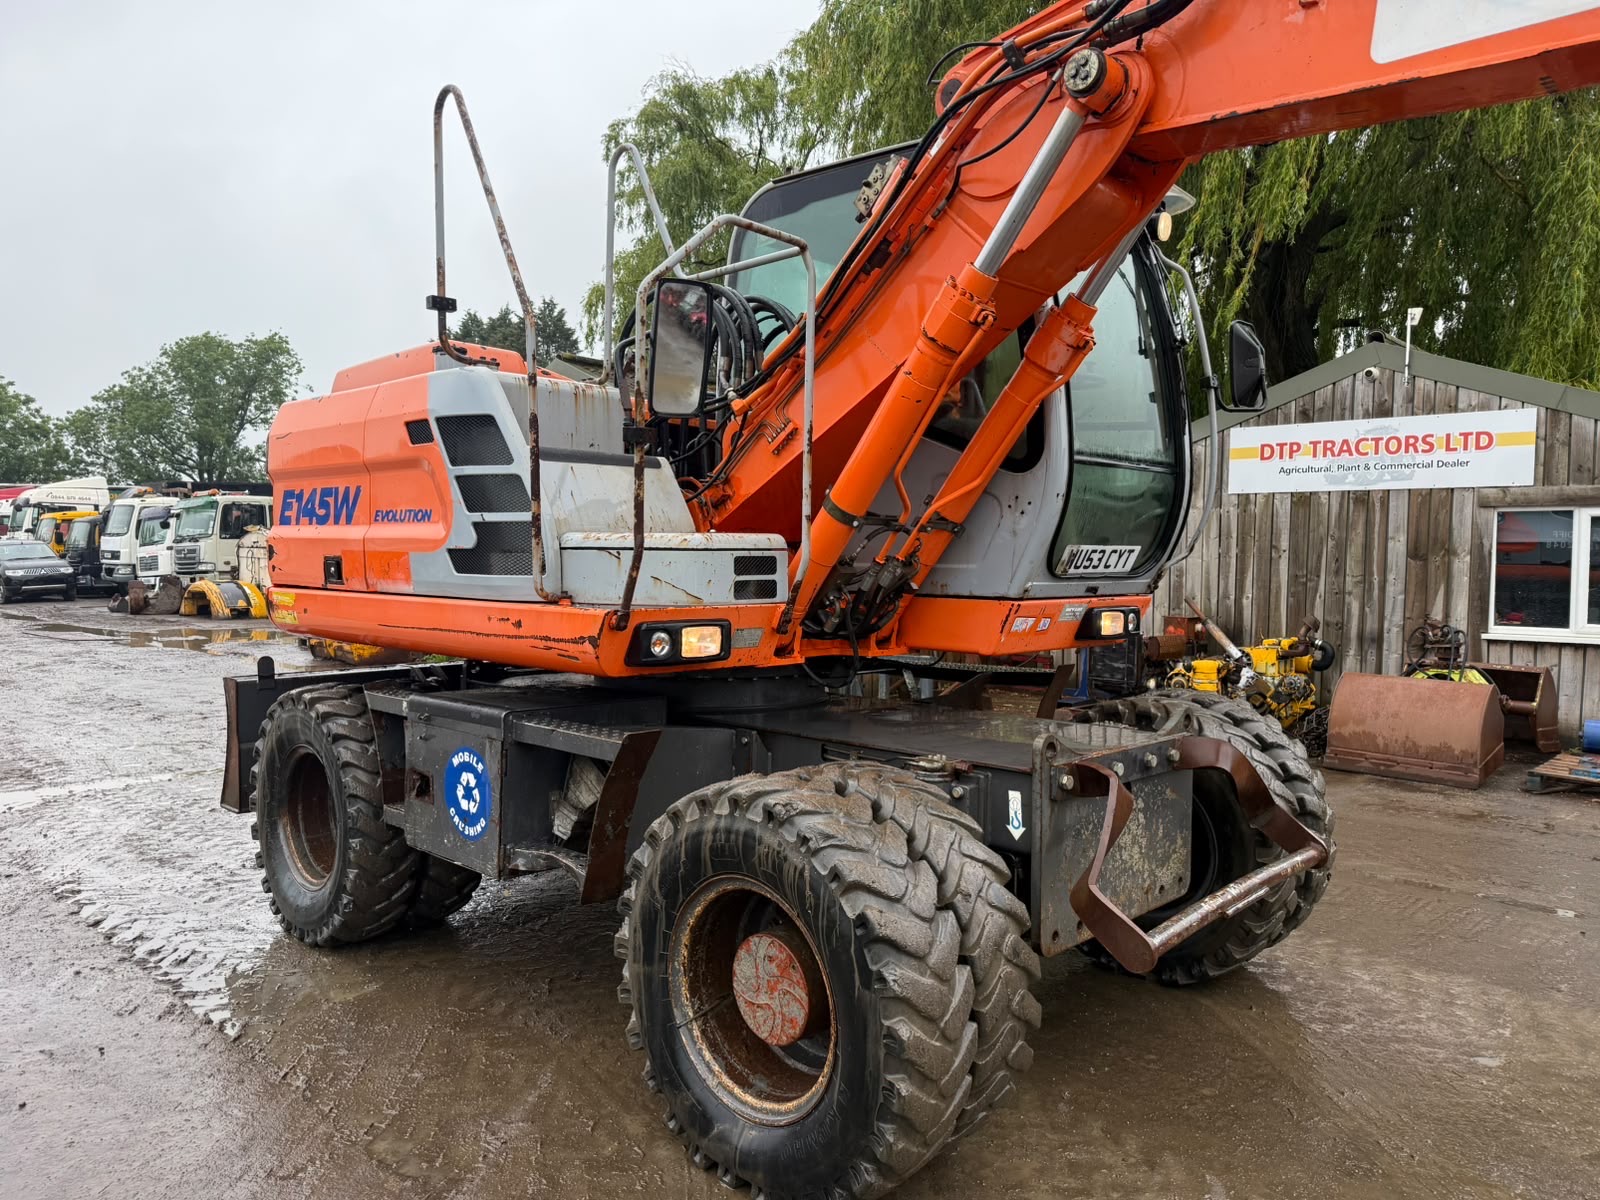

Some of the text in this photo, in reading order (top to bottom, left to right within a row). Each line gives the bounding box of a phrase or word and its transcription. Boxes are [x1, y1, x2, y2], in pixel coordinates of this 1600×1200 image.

[1260, 431, 1494, 461] DTP TRACTORS LTD
[1279, 459, 1470, 476] Agricultural, Plant & Commercial Dealer
[279, 485, 362, 526] E145W
[374, 509, 432, 523] EVOLUTION
[1103, 549, 1136, 570] CYT
[452, 751, 484, 774] MOBILE
